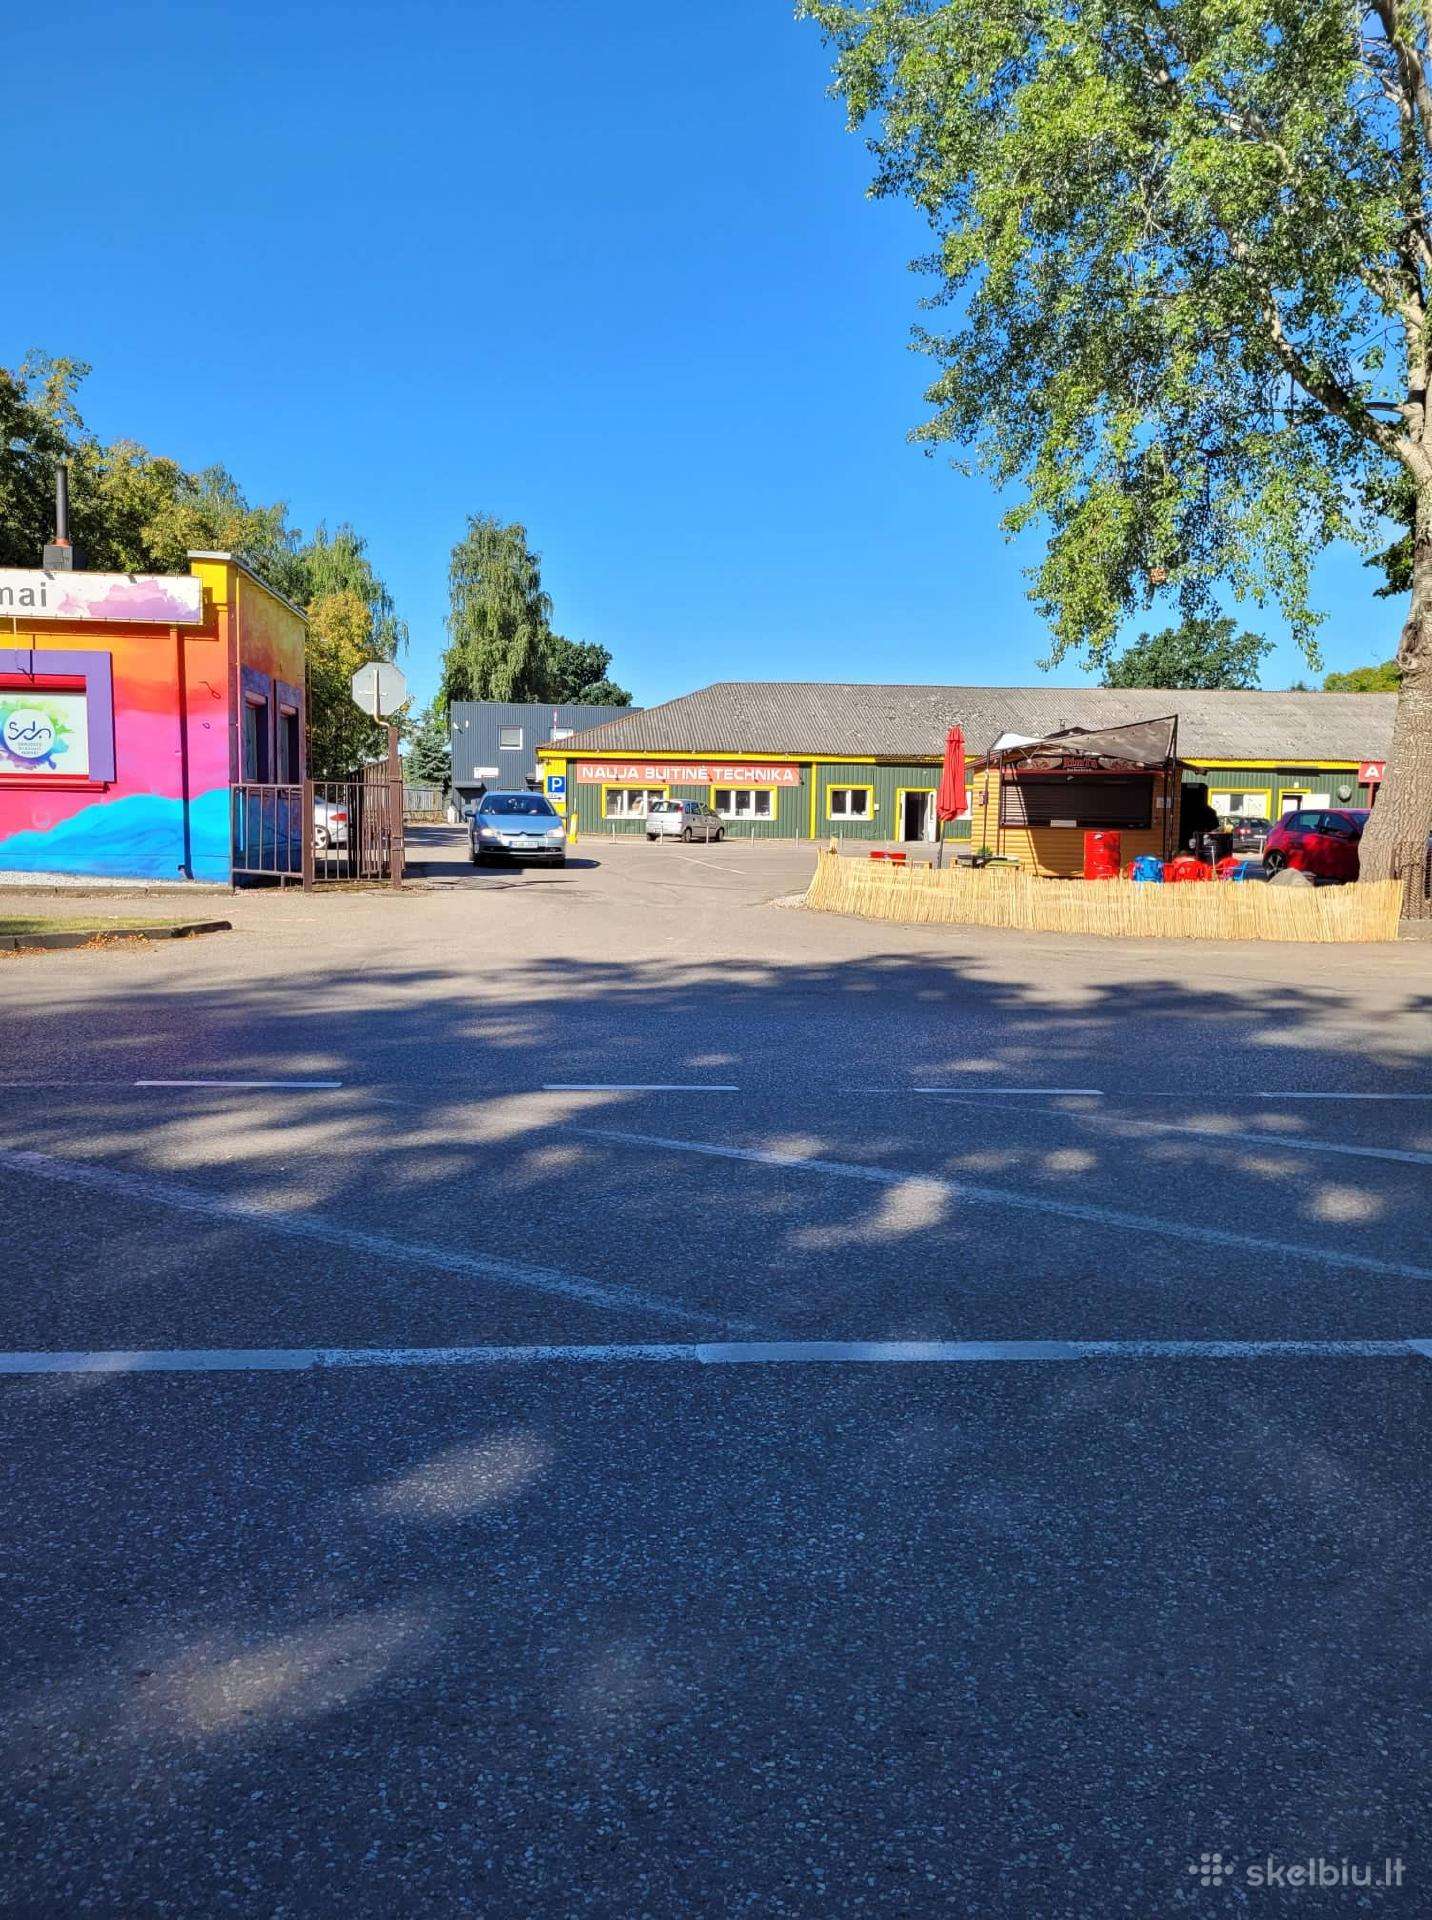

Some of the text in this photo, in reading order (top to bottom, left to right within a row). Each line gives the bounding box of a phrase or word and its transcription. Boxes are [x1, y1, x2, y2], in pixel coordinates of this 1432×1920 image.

[582, 766, 638, 779] NAUJA
[713, 768, 793, 781] TECHNIKA
[551, 777, 563, 792] P
